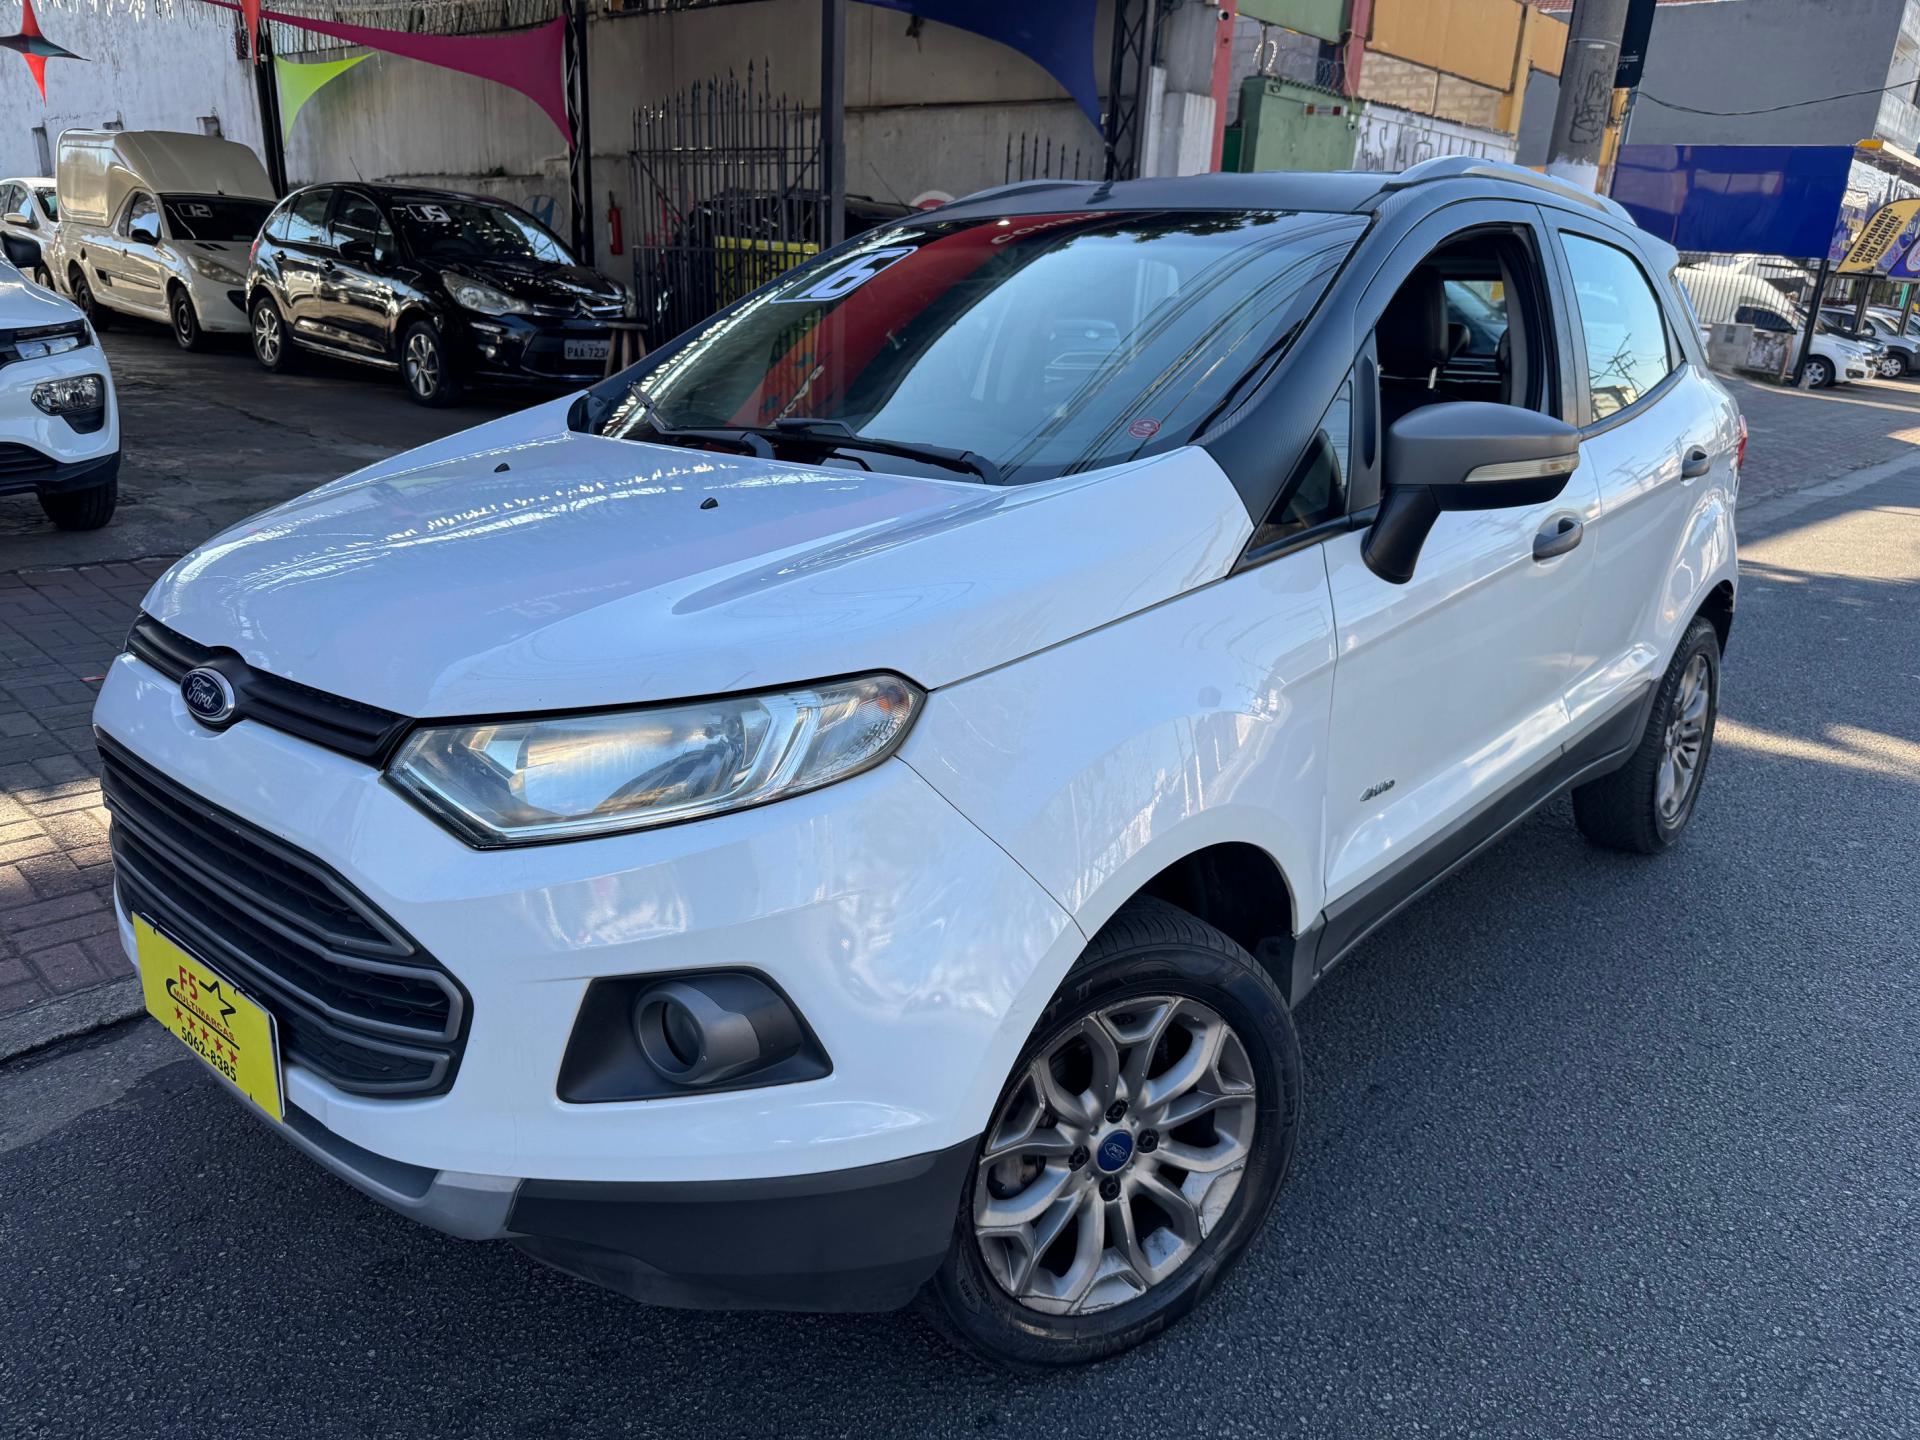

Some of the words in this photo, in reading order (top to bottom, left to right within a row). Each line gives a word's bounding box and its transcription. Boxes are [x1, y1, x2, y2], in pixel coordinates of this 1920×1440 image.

[1850, 206, 1893, 263] COMPRAMOS
[1861, 245, 1878, 263] SEU
[186, 676, 217, 709] Ford
[178, 964, 199, 1001] F5
[174, 989, 235, 1042] MULTIMARCAS
[181, 1027, 237, 1083] 5062-8385
